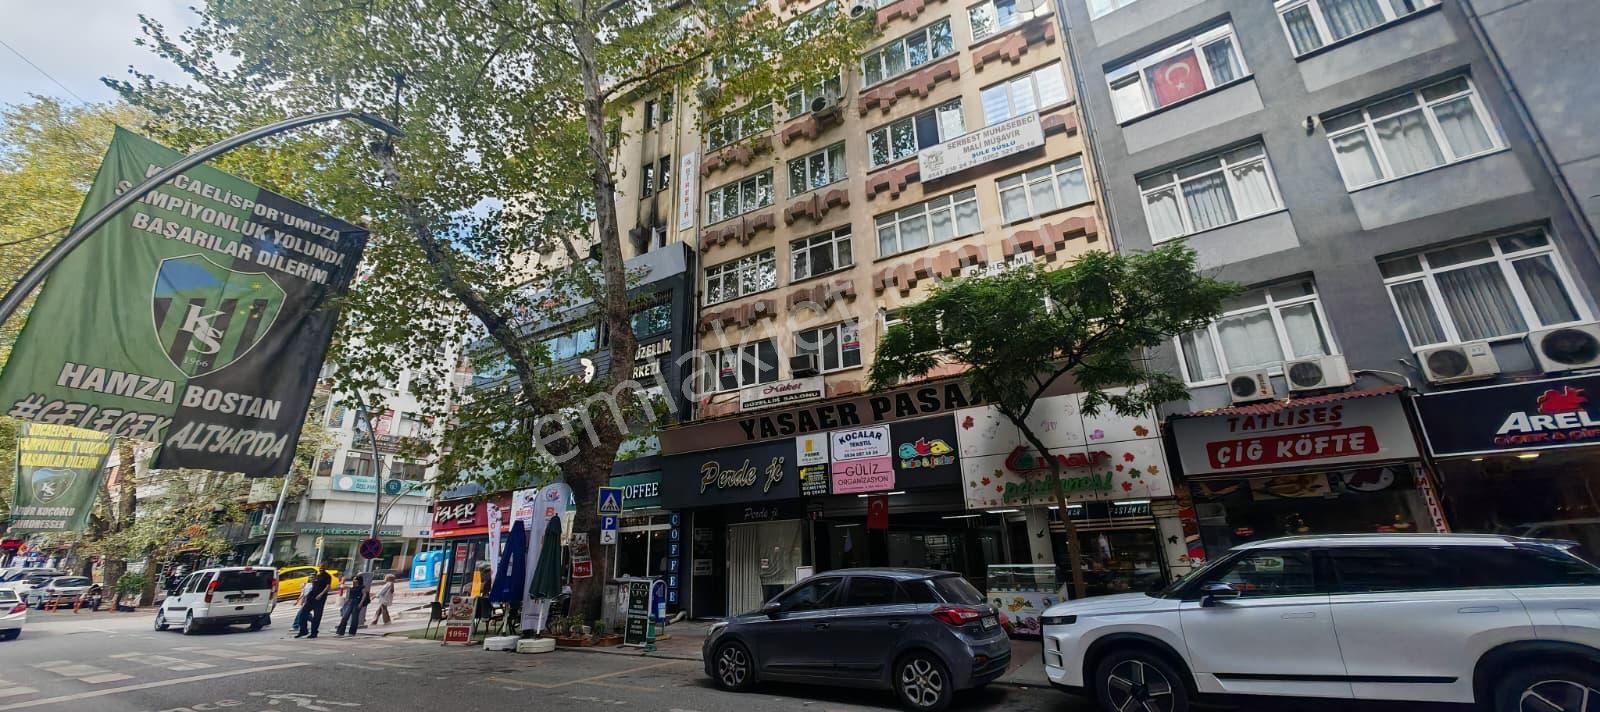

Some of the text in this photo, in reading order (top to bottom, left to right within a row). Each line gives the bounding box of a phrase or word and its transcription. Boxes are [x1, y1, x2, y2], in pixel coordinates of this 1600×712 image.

[947, 133, 981, 151] SERBEST
[145, 164, 340, 243] KCAELİSPOR'UMUZA
[115, 180, 346, 266] ŞMPİYONLUK YOLUNDA
[131, 212, 329, 285] BAŞARILAR DİLERİM
[56, 362, 282, 421] HAMZA BOSTAN
[739, 404, 860, 441] YASAER
[1227, 404, 1344, 433] TATLISES
[838, 430, 882, 445] KOCALAR
[1217, 431, 1367, 468] ÇİĞ KÖFTE
[699, 459, 758, 494] Perde
[837, 475, 889, 486] ORGANİZASYON
[845, 462, 880, 477] GÜLİZ
[622, 481, 659, 499] OFFEE
[604, 518, 614, 529] P
